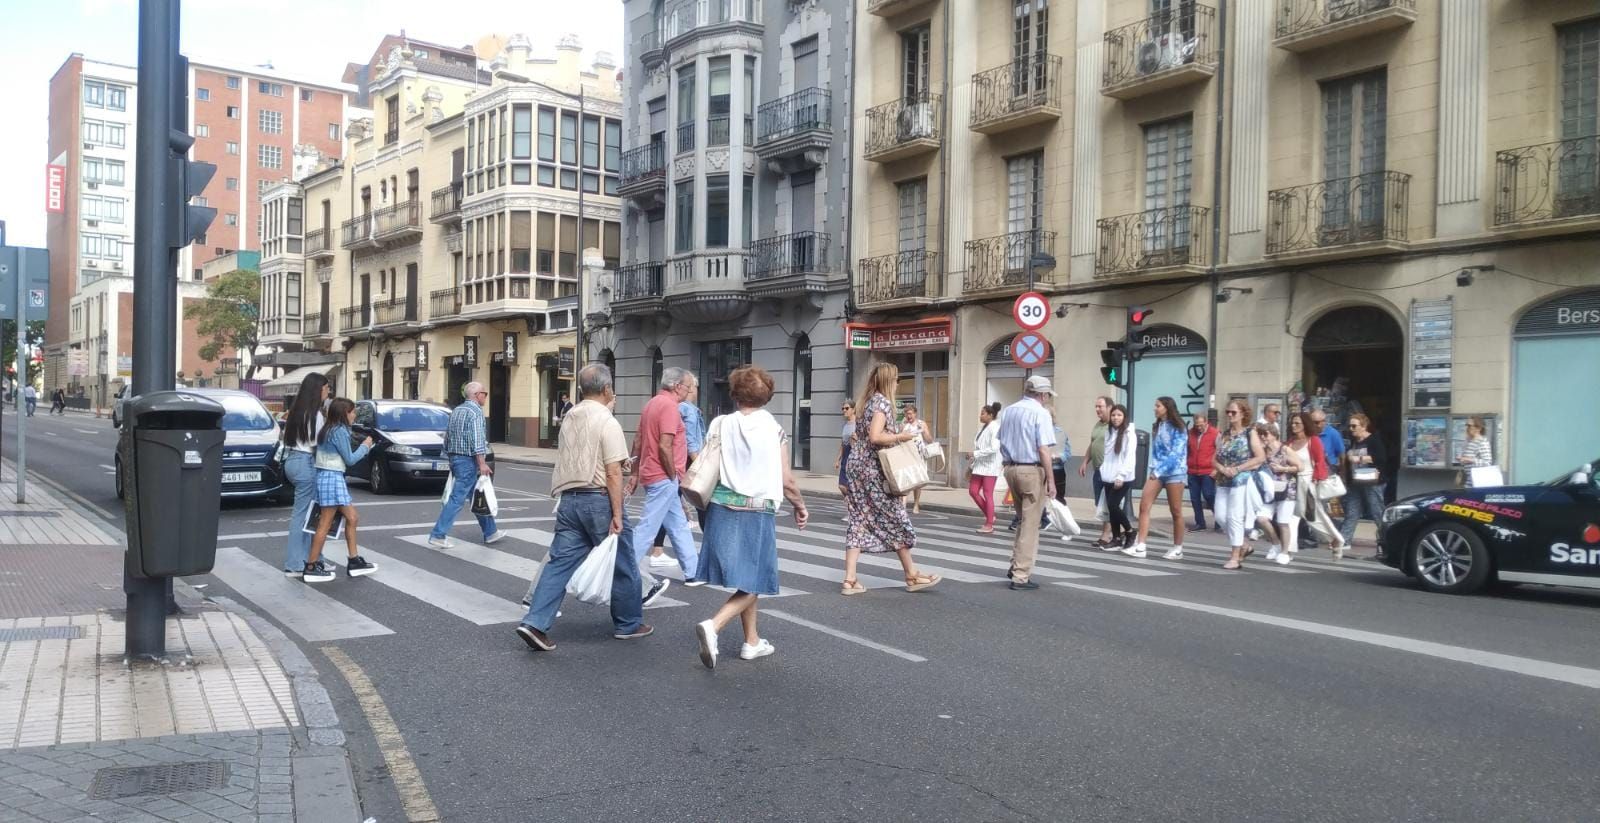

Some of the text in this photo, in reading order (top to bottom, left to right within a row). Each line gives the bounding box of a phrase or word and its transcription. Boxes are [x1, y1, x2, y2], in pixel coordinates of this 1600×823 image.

[1022, 305, 1042, 318] 30
[1558, 307, 1600, 324] Bers
[1142, 333, 1188, 347] Bershka
[1442, 504, 1495, 522] DRONES
